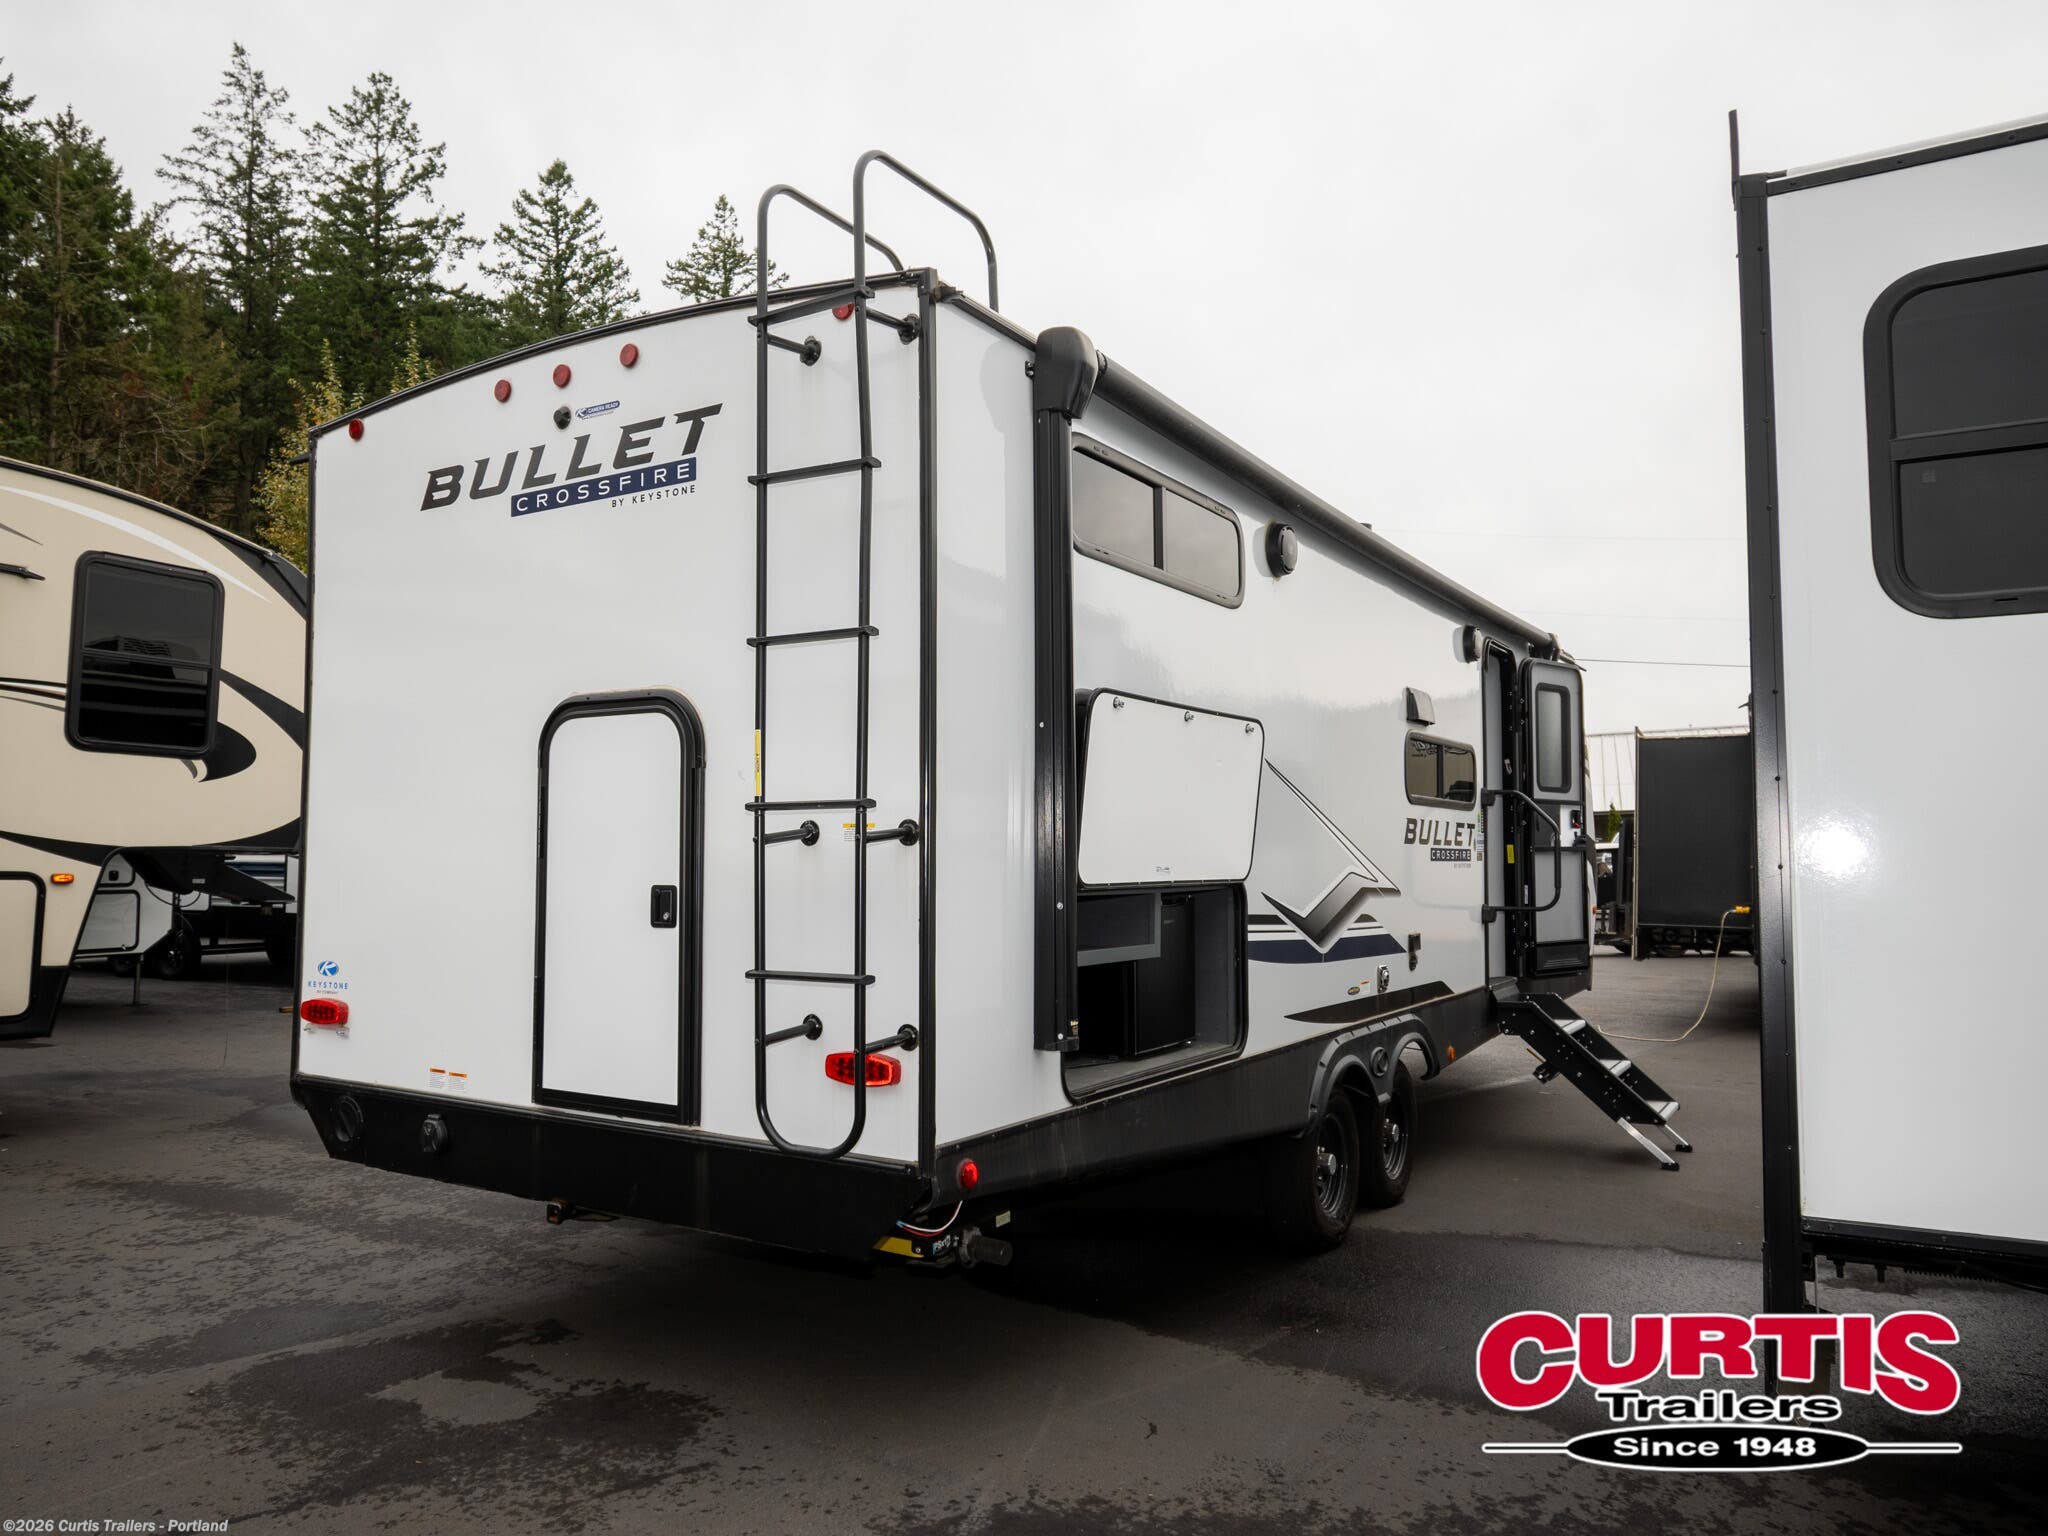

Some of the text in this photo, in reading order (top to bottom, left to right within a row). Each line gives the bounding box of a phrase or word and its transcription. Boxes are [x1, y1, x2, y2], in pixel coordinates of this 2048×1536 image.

[605, 402, 619, 410] READY
[420, 403, 723, 511] BULLET
[516, 463, 691, 512] CROSSFIRE
[611, 485, 697, 508] BY KEYSTONE
[1404, 817, 1475, 847] BULLET
[1431, 850, 1471, 860] CROSSFIRE
[308, 980, 349, 990] KEYSTONE
